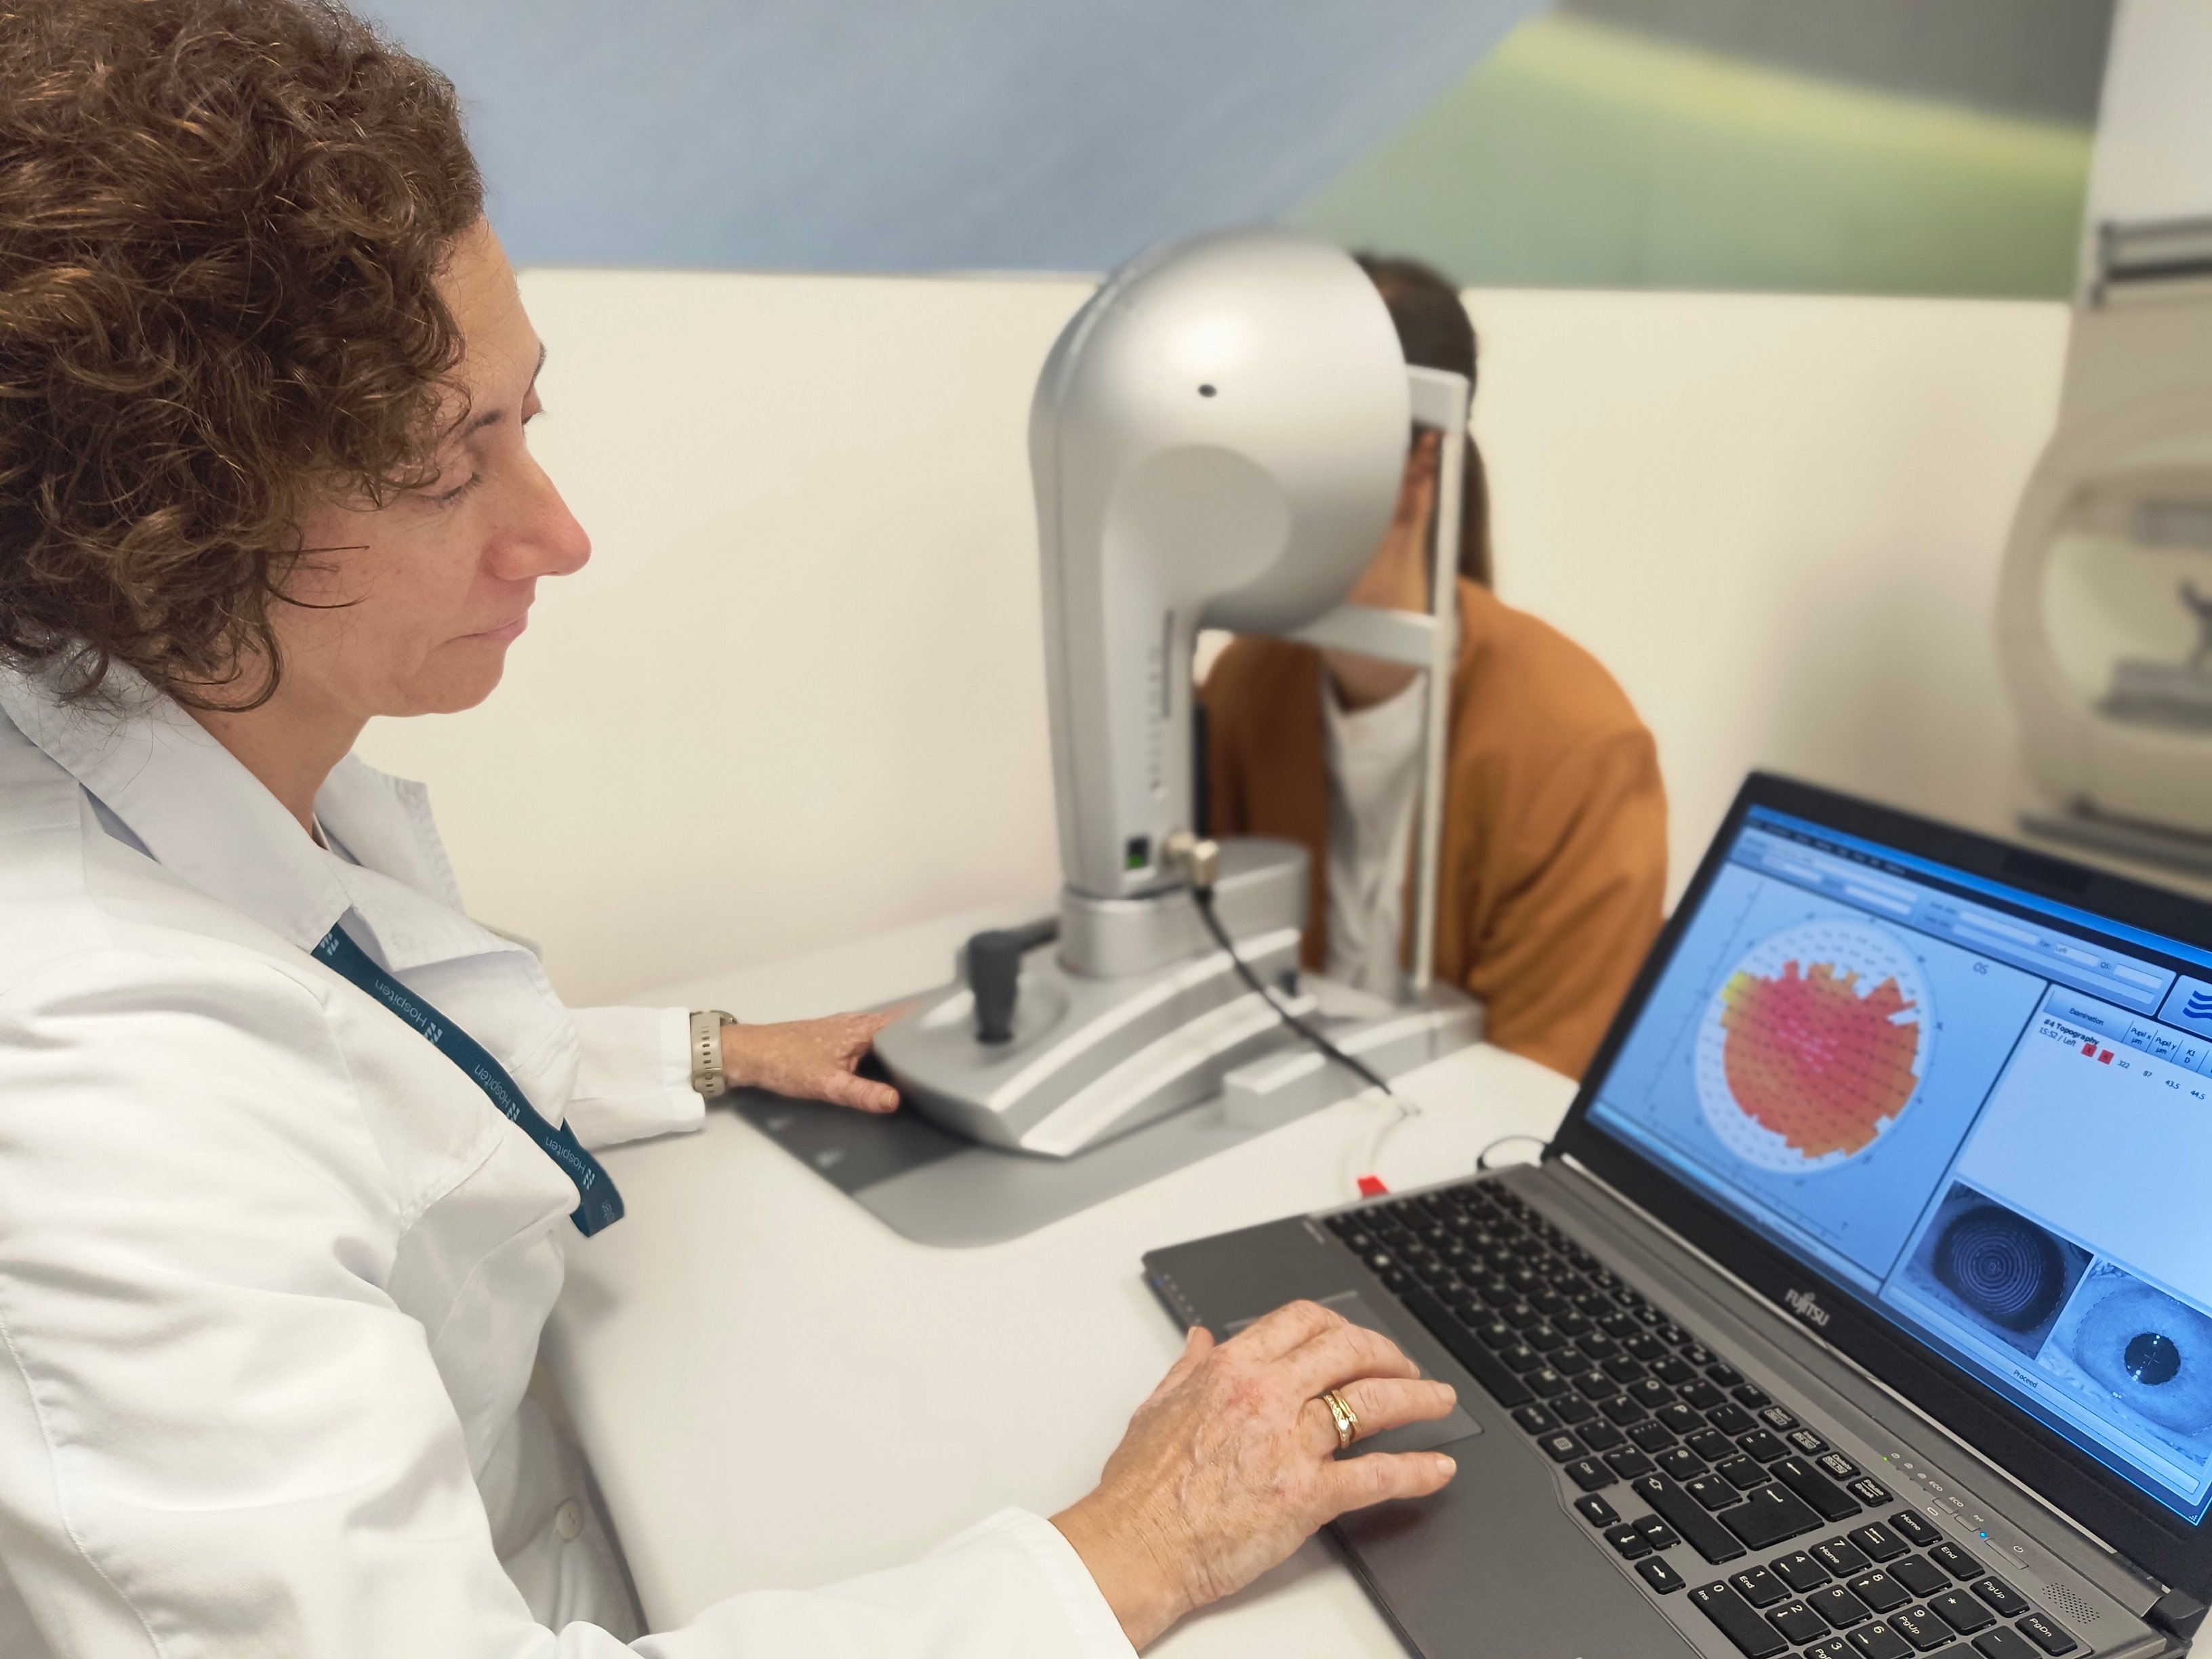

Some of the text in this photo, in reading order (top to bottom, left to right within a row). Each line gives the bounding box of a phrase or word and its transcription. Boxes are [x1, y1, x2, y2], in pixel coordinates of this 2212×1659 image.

[1973, 962, 1989, 975] OS
[375, 979, 427, 1027] Hospiten
[2069, 1008, 2104, 1025] Examination
[2055, 1023, 2100, 1046] Topography
[2131, 1027, 2147, 1039] Pupil
[2063, 1036, 2076, 1048] Left
[2155, 1037, 2171, 1049] Pupil
[2117, 1060, 2130, 1069] 322
[474, 1064, 511, 1108] Hospiten
[2165, 1080, 2180, 1090] 43.5
[2190, 1090, 2206, 1100] 44.5
[545, 1136, 586, 1174] Hospiten
[1784, 1288, 1830, 1326] FUJITSU
[2013, 1369, 2038, 1389] Proceed
[1674, 1404, 1688, 1413] P
[1832, 1454, 1852, 1471] Delete
[1855, 1483, 1875, 1498] Break
[1864, 1479, 1884, 1496] Pause
[1929, 1481, 1943, 1492] ECO
[1949, 1496, 1964, 1507] ECO
[1900, 1513, 1921, 1531] Home
[1833, 1539, 1846, 1547] 7
[1819, 1546, 1840, 1564] Home
[1941, 1546, 1958, 1559] End
[1739, 1575, 1755, 1589] End
[1872, 1574, 1884, 1582] 8
[1698, 1590, 1709, 1601] Ins
[1984, 1580, 2005, 1599] PgUp
[1790, 1604, 1803, 1613] 2
[1914, 1610, 1925, 1618] 9
[1873, 1625, 1885, 1634] 6
[1899, 1616, 1920, 1635] PgUp
[2030, 1618, 2052, 1637] PgDn
[1830, 1641, 1843, 1650] 3
